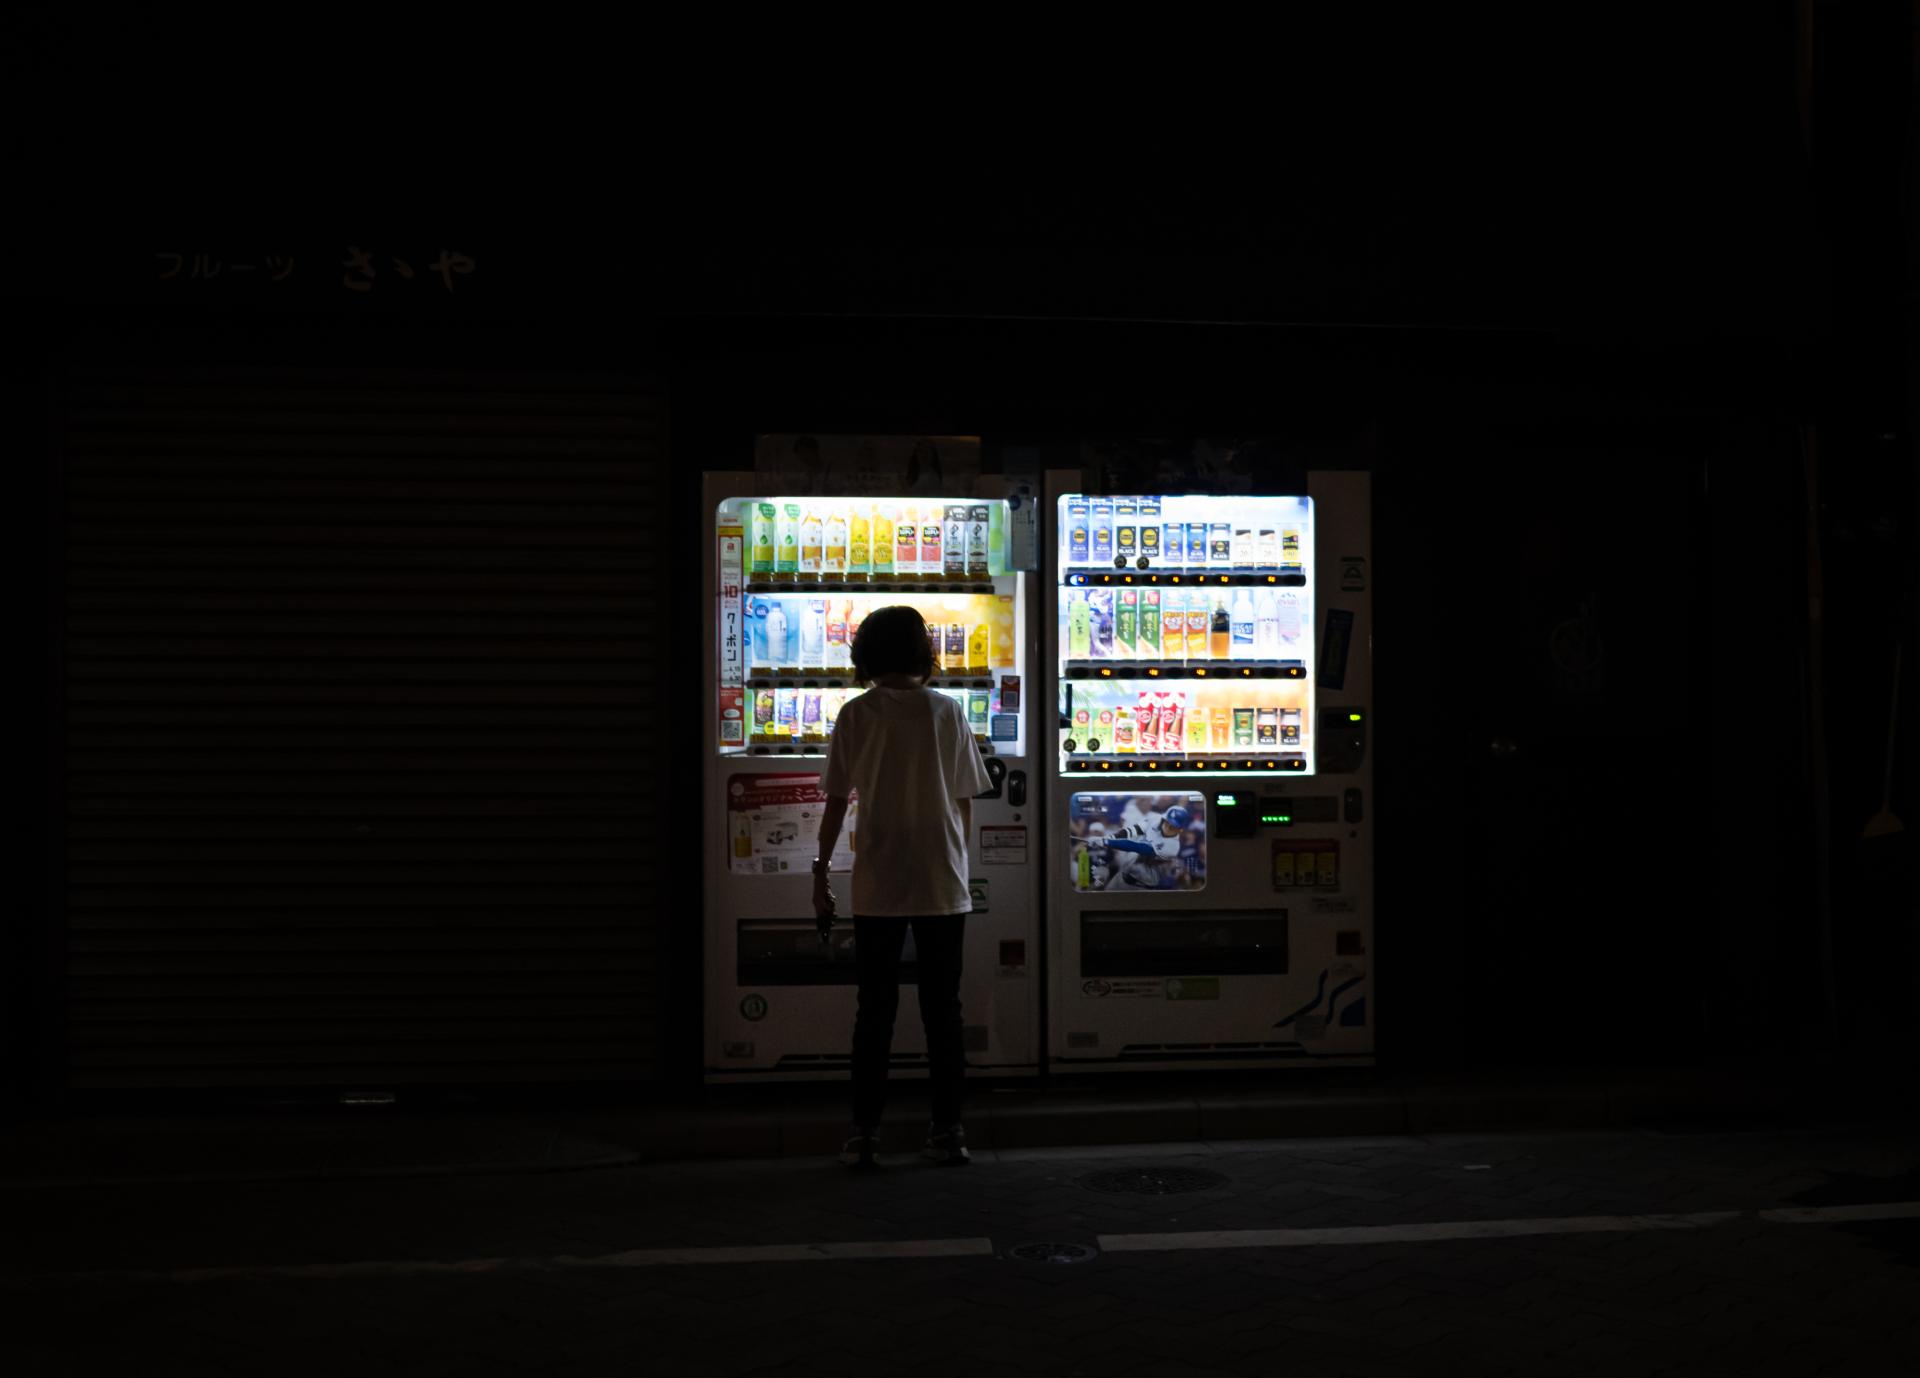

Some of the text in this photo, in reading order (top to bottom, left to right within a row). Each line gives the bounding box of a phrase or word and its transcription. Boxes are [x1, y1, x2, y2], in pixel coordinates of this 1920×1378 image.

[153, 252, 297, 280] フルーツ
[726, 612, 737, 661] クーポン
